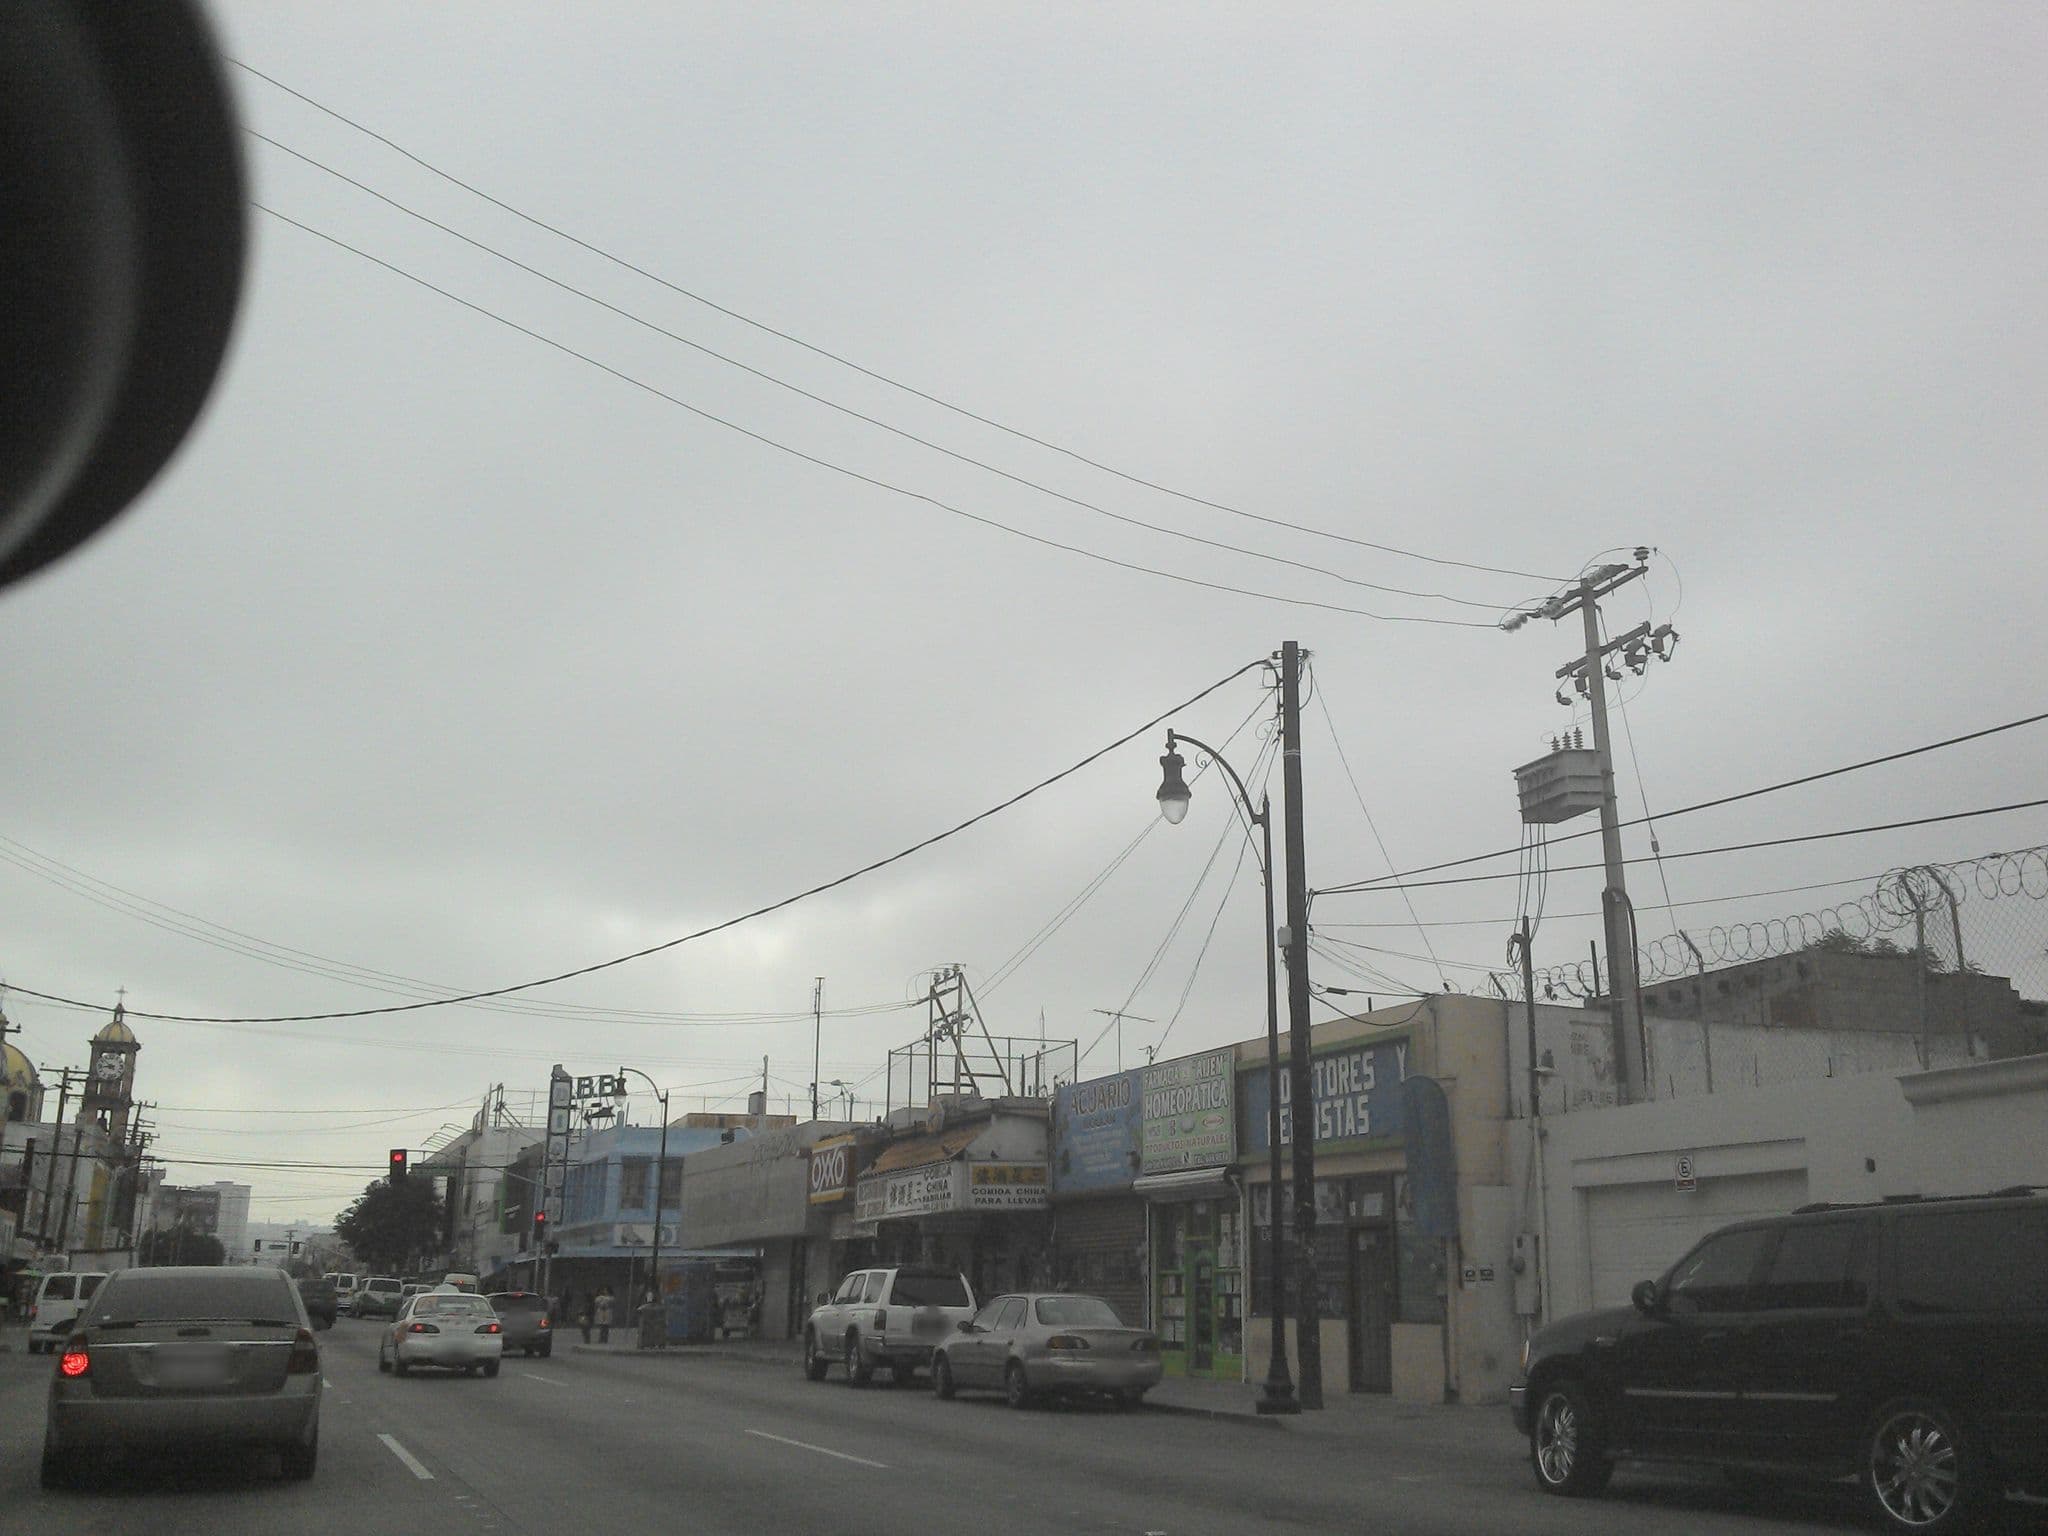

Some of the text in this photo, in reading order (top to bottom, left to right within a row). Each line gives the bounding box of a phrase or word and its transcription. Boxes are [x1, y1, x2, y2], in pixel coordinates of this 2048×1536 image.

[1280, 1043, 1407, 1105] DTORES Y
[1070, 1078, 1132, 1116] ACUARIO
[1186, 1133, 1228, 1147] NATURALES
[812, 1147, 845, 1191] OXXO
[925, 1178, 949, 1194] CHINA
[971, 1187, 1047, 1196] COMIDA CHINA
[974, 1197, 1003, 1206] PARA
